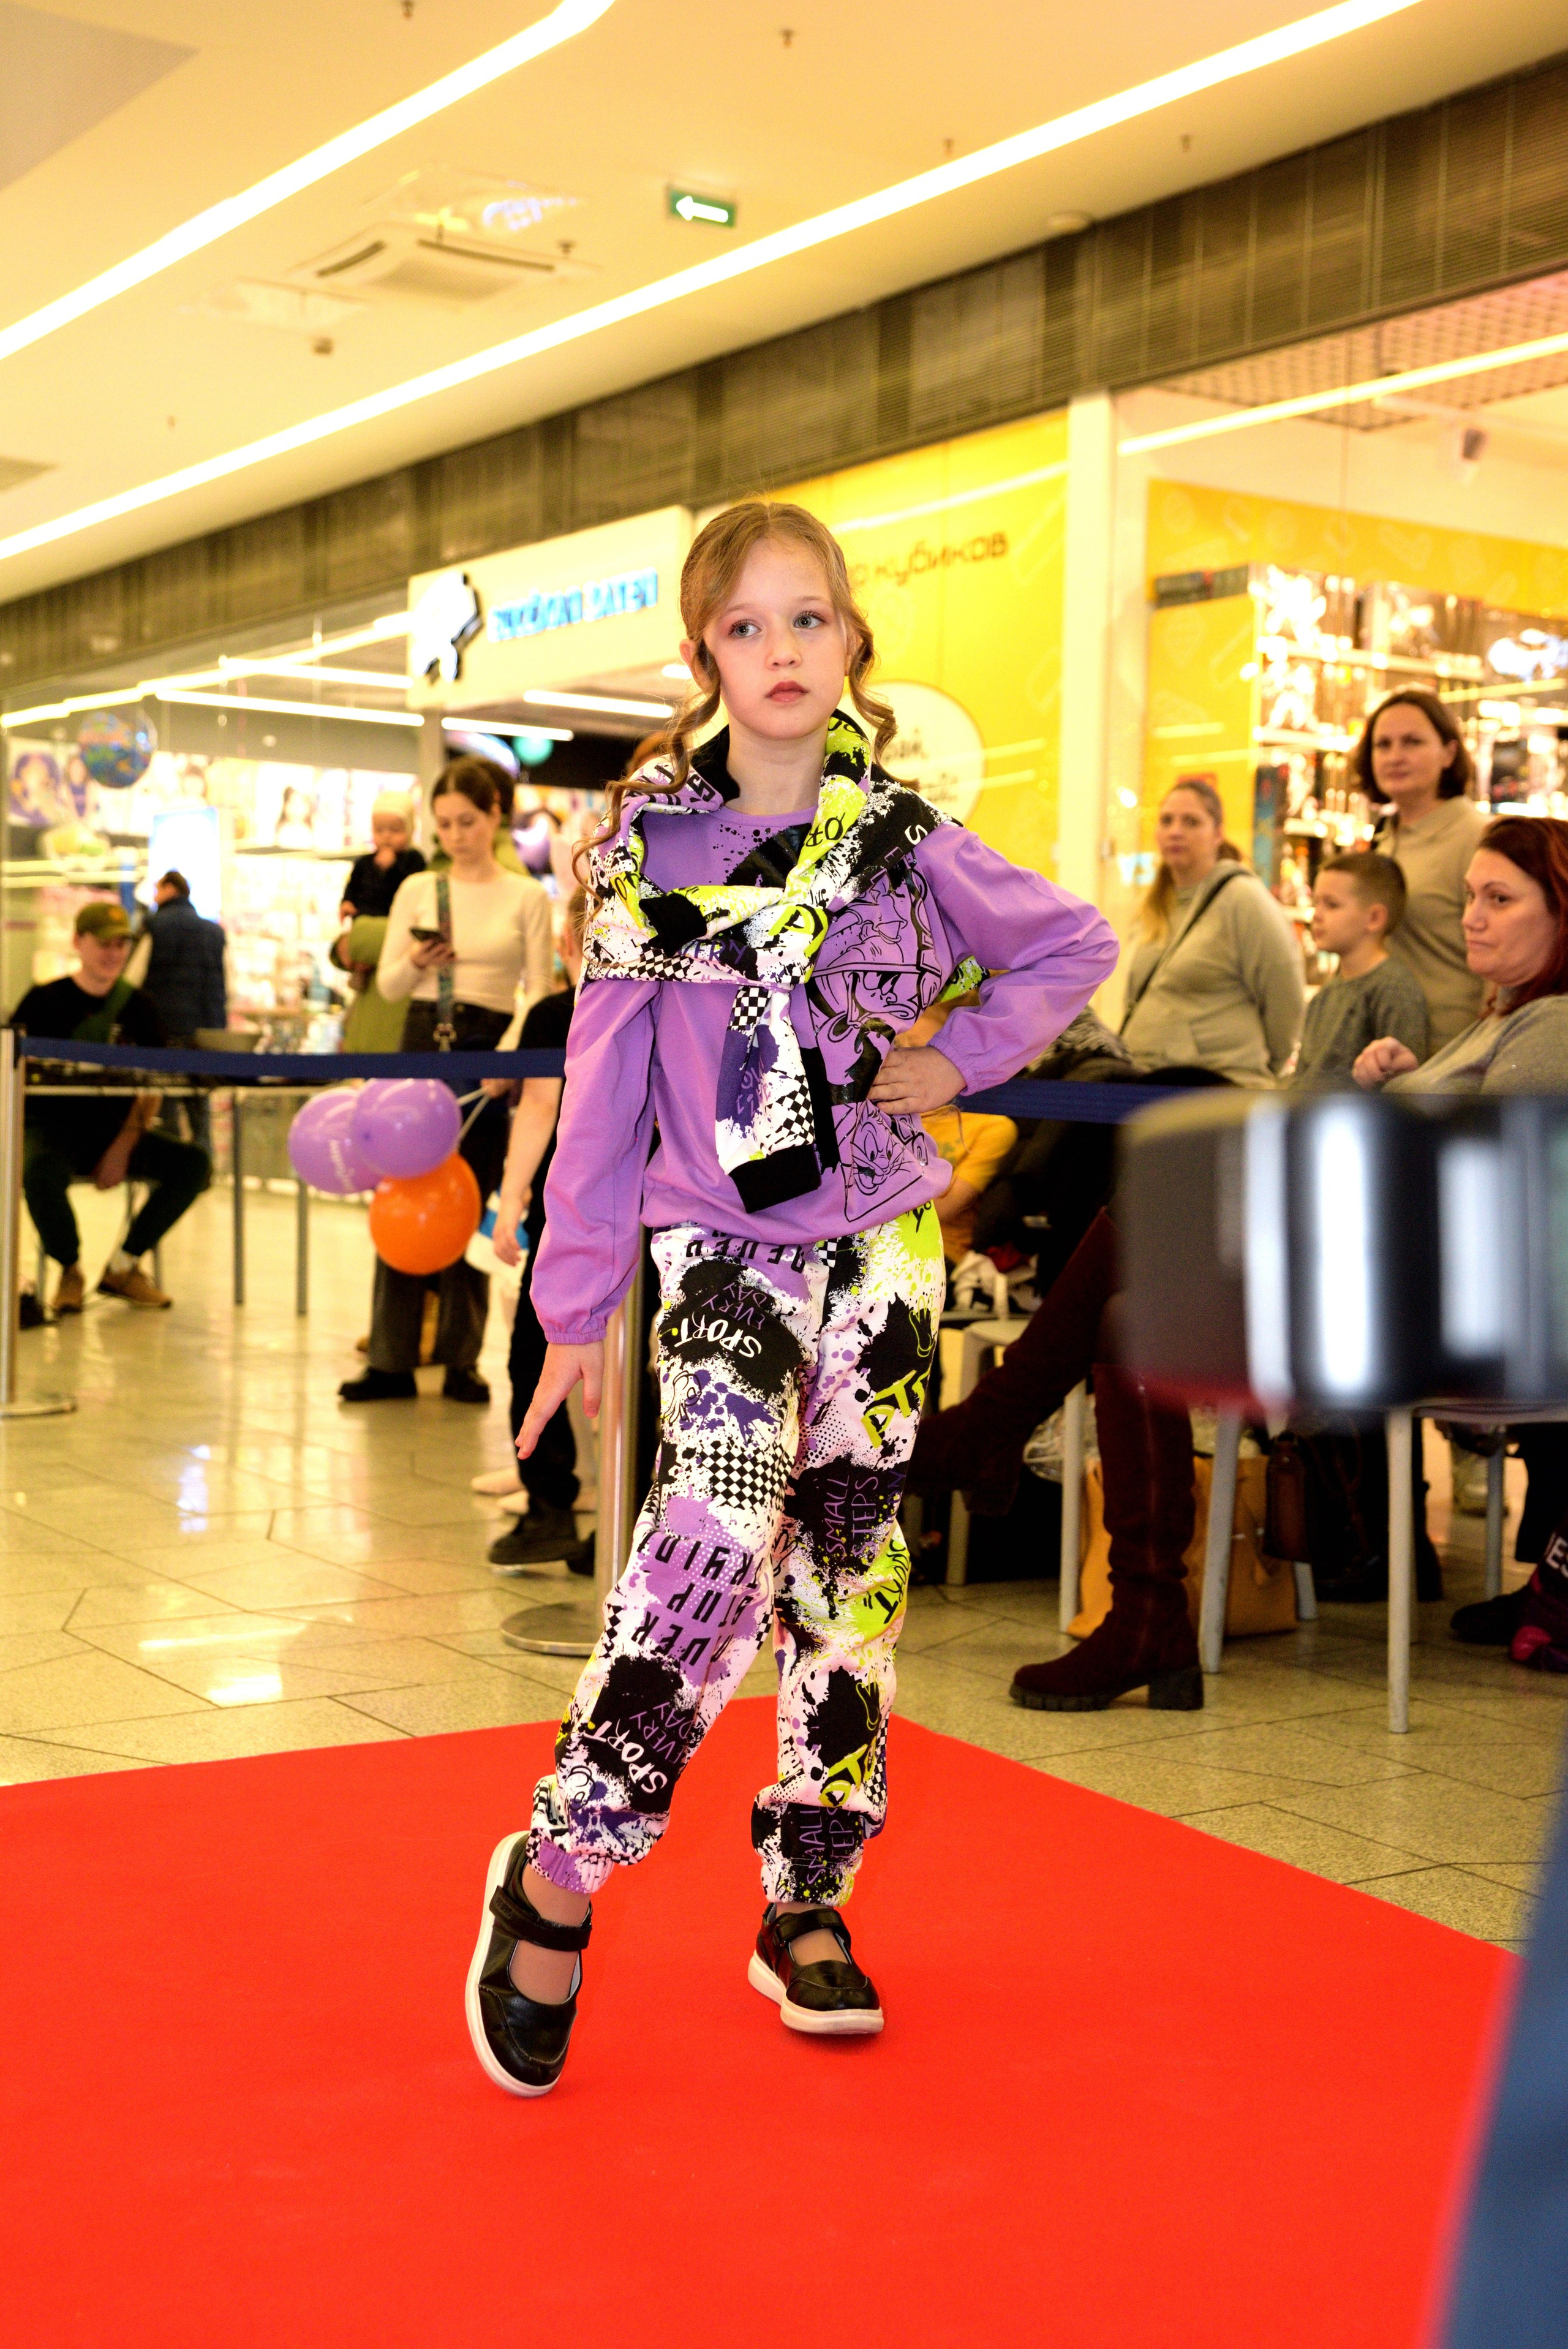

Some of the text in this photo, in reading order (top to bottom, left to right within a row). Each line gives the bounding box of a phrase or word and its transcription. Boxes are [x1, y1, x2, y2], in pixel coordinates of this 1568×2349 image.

[701, 1294, 765, 1330] EVERY
[723, 1282, 767, 1308] DAY
[674, 1313, 762, 1358] SPORT
[824, 1474, 850, 1561] SMALL
[851, 1476, 878, 1556] STEPS
[666, 1583, 754, 1627] STOP
[628, 1710, 682, 1763] EVERY
[653, 1701, 693, 1740] DAY
[584, 1719, 668, 1794] SPORT
[799, 1806, 826, 1885] SMALL
